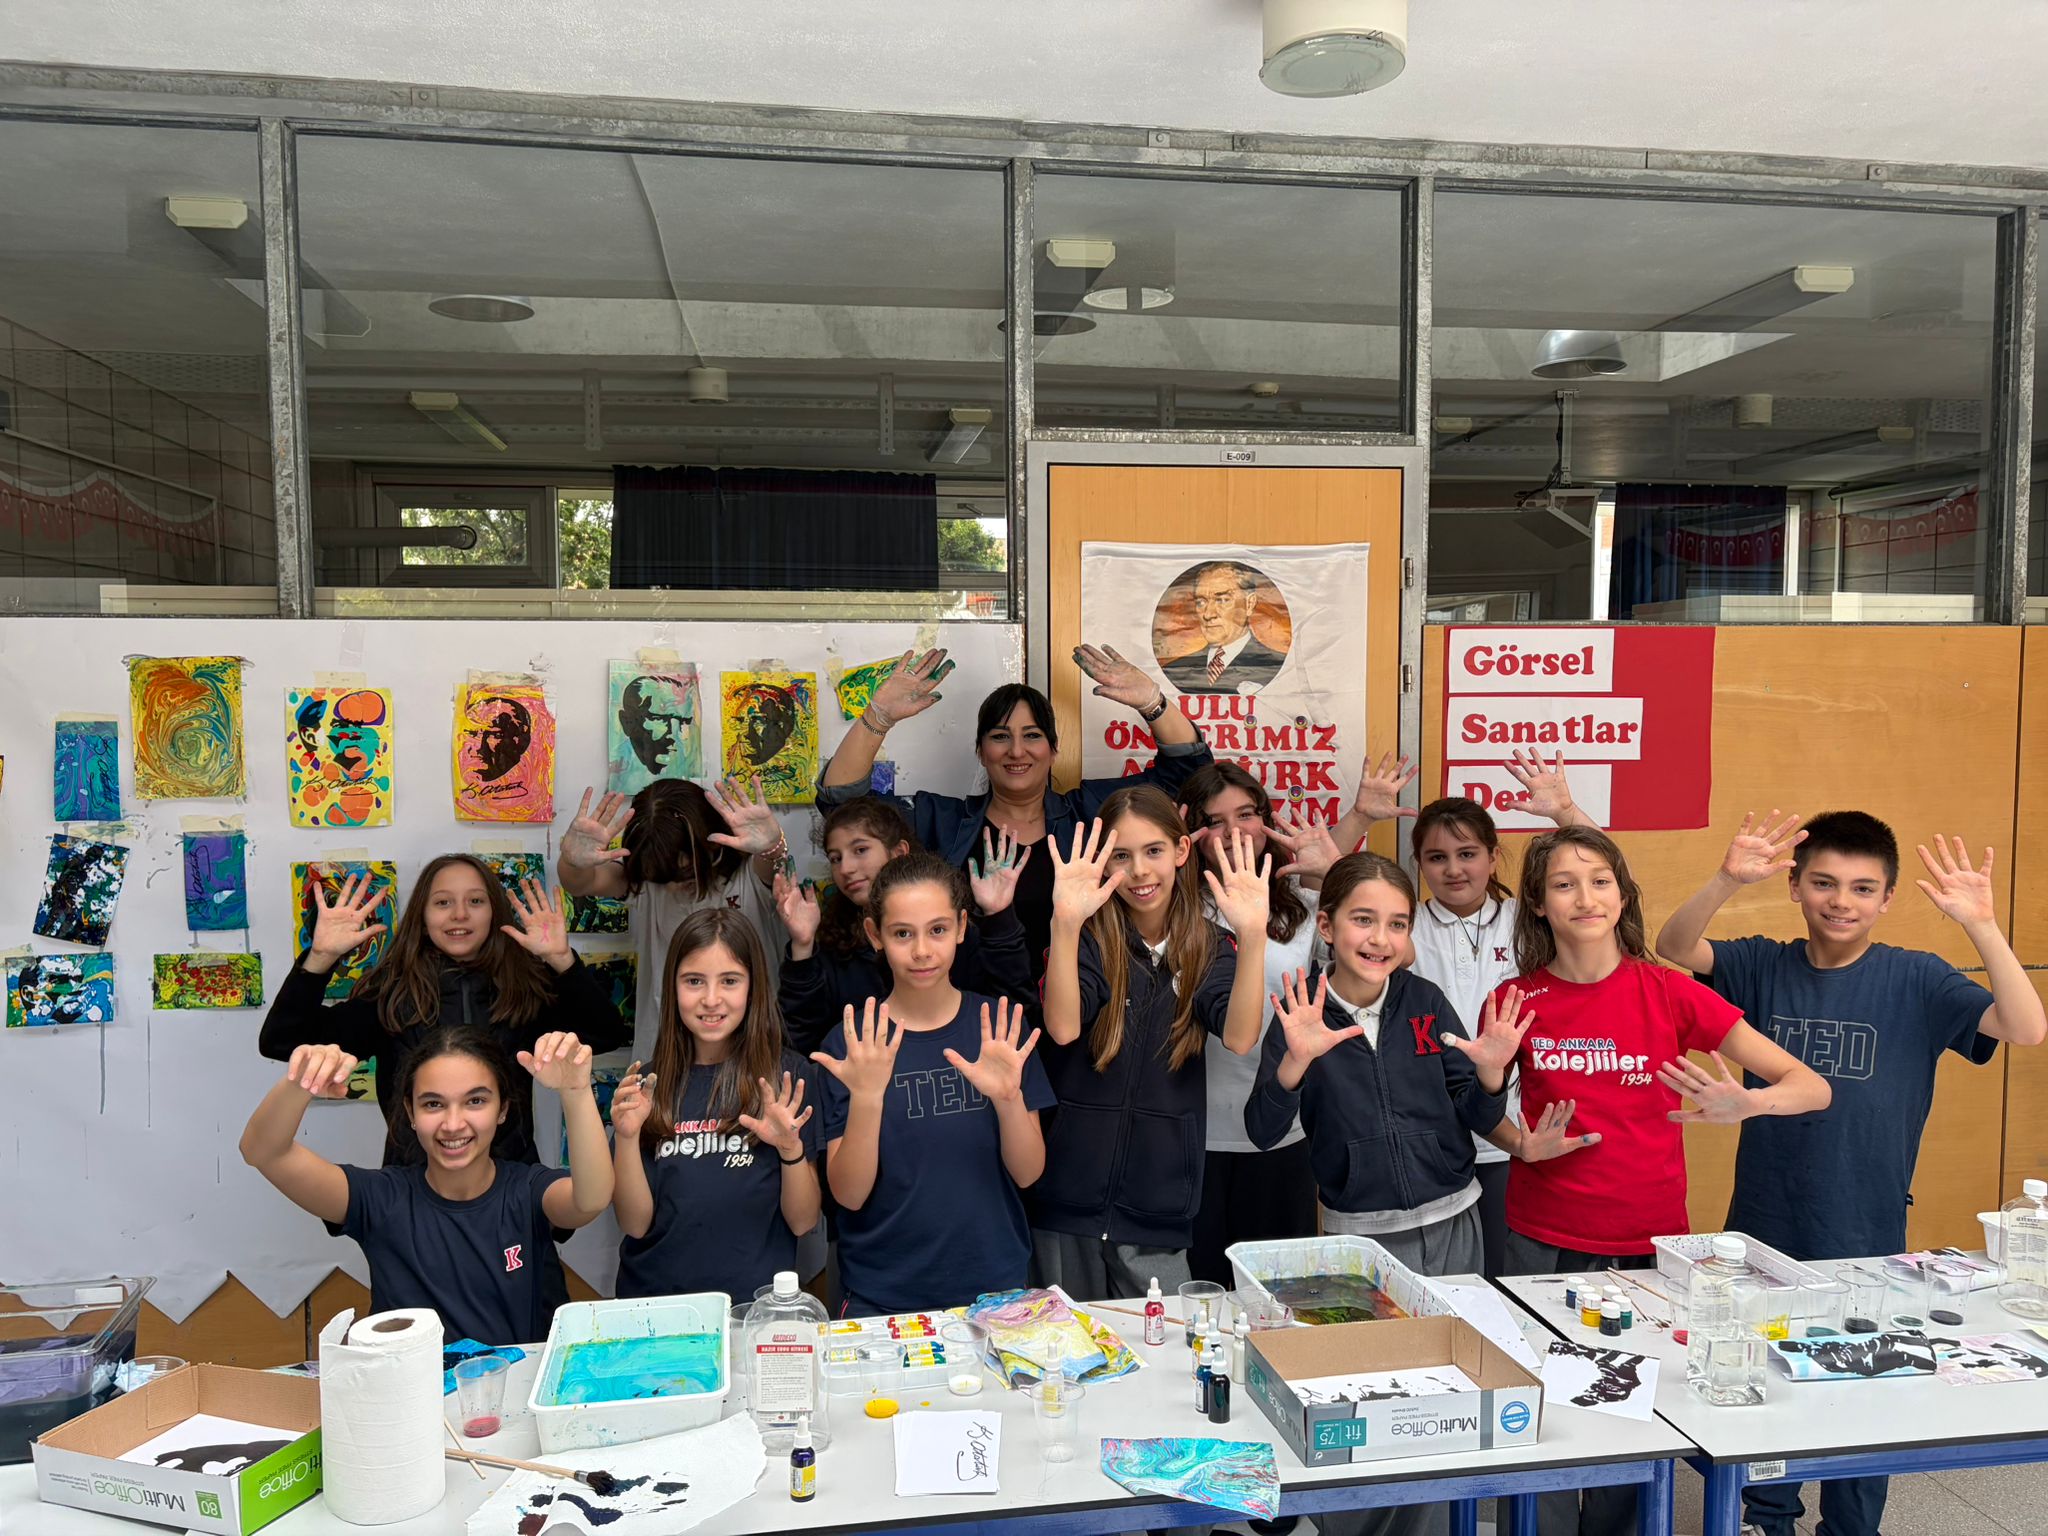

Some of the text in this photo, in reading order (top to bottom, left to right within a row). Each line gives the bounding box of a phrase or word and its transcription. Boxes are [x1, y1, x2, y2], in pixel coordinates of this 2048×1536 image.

[1226, 453, 1251, 461] E-009
[1463, 645, 1594, 676] Görsel
[1178, 695, 1256, 721] ULU
[1461, 714, 1638, 743] Sanatlar
[1462, 782, 1533, 812] Der
[726, 894, 741, 909] K
[1493, 947, 1509, 962] K
[1409, 1014, 1442, 1056] K
[1531, 1037, 1617, 1051] TED ANKARA
[1768, 1015, 1878, 1080] TED
[1532, 1051, 1649, 1076] Kolejliler
[1620, 1072, 1653, 1086] 1954
[674, 1119, 721, 1133] ANKAR
[655, 1132, 750, 1161] olejliler
[723, 1154, 755, 1168] 1954
[504, 1244, 523, 1271] K
[1319, 1424, 1362, 1445] fit 75
[1391, 1416, 1477, 1437] MultiOffice
[94, 1480, 186, 1512] MultiOffice
[200, 1500, 218, 1516] 80
